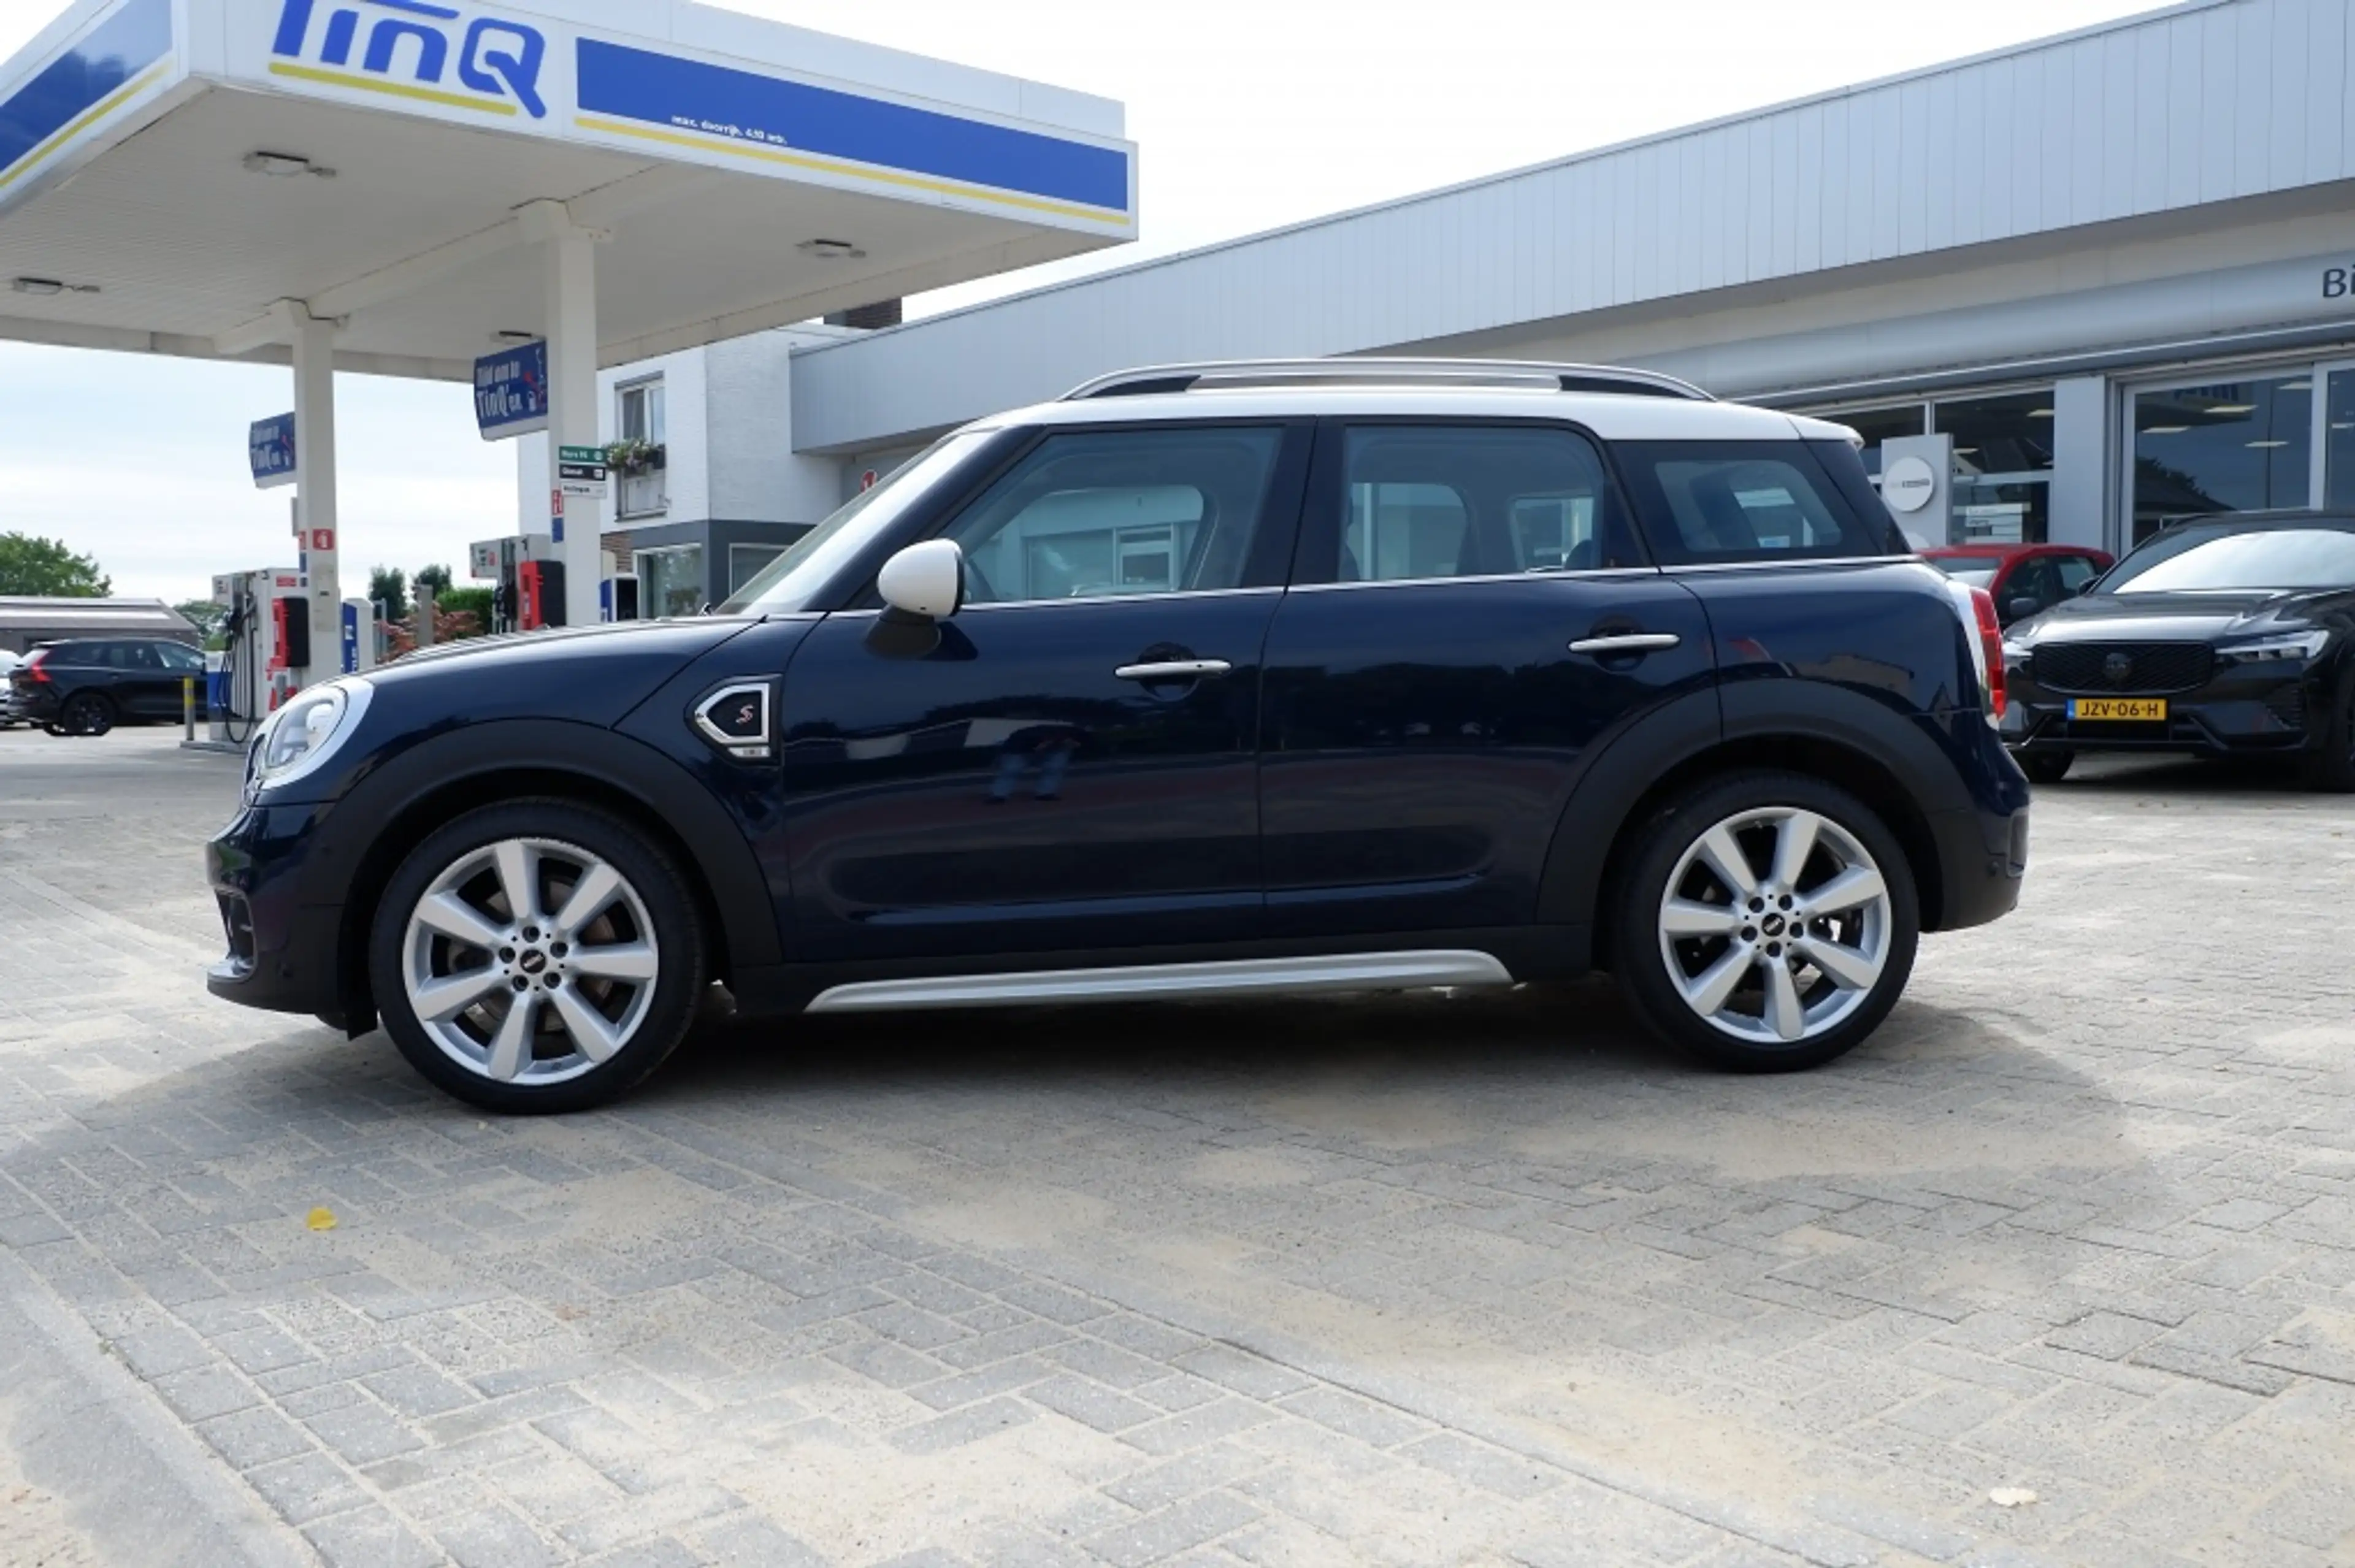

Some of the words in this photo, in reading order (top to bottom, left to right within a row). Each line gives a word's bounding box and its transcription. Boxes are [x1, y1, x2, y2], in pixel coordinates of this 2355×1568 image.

[272, 0, 546, 118] TinQ
[736, 704, 754, 725] S
[2081, 702, 2158, 716] JZV-06-H
